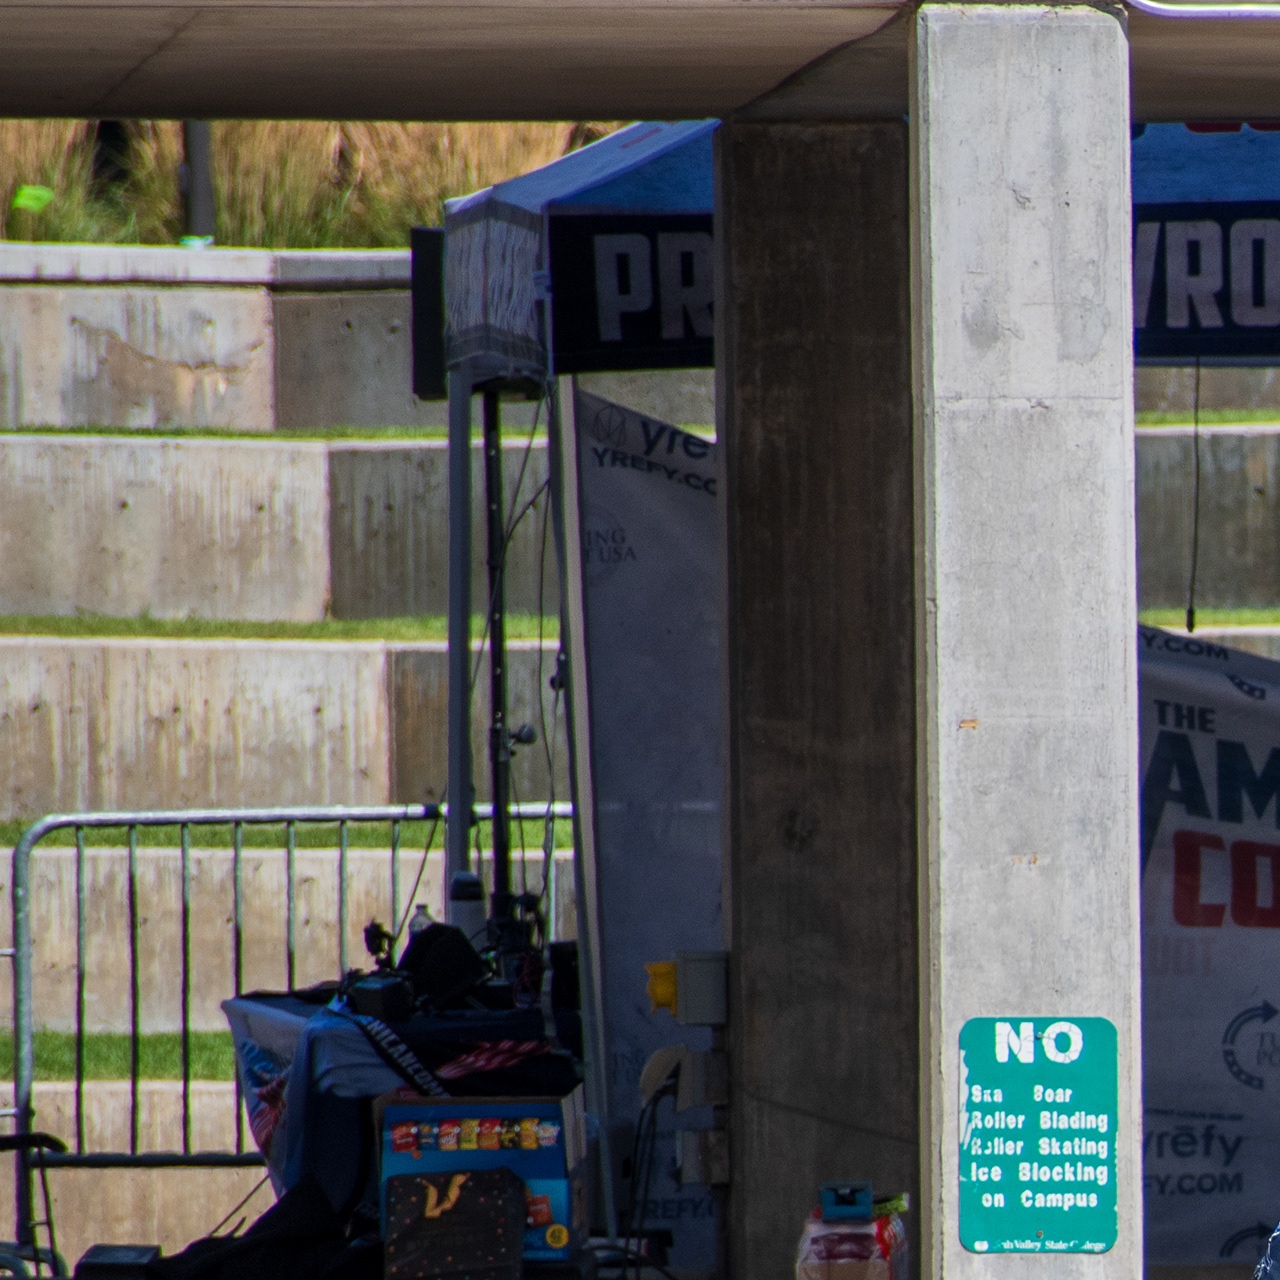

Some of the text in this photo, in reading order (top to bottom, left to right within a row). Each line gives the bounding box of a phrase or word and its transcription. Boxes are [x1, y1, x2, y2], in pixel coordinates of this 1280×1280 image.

[1153, 698, 1217, 734] THE
[994, 1021, 1083, 1064] NO
[971, 1110, 1109, 1133] Roller Blading
[1038, 1137, 1109, 1159] Skating
[970, 1161, 1109, 1185] Ice Blocking
[981, 1189, 1098, 1211] on Campus
